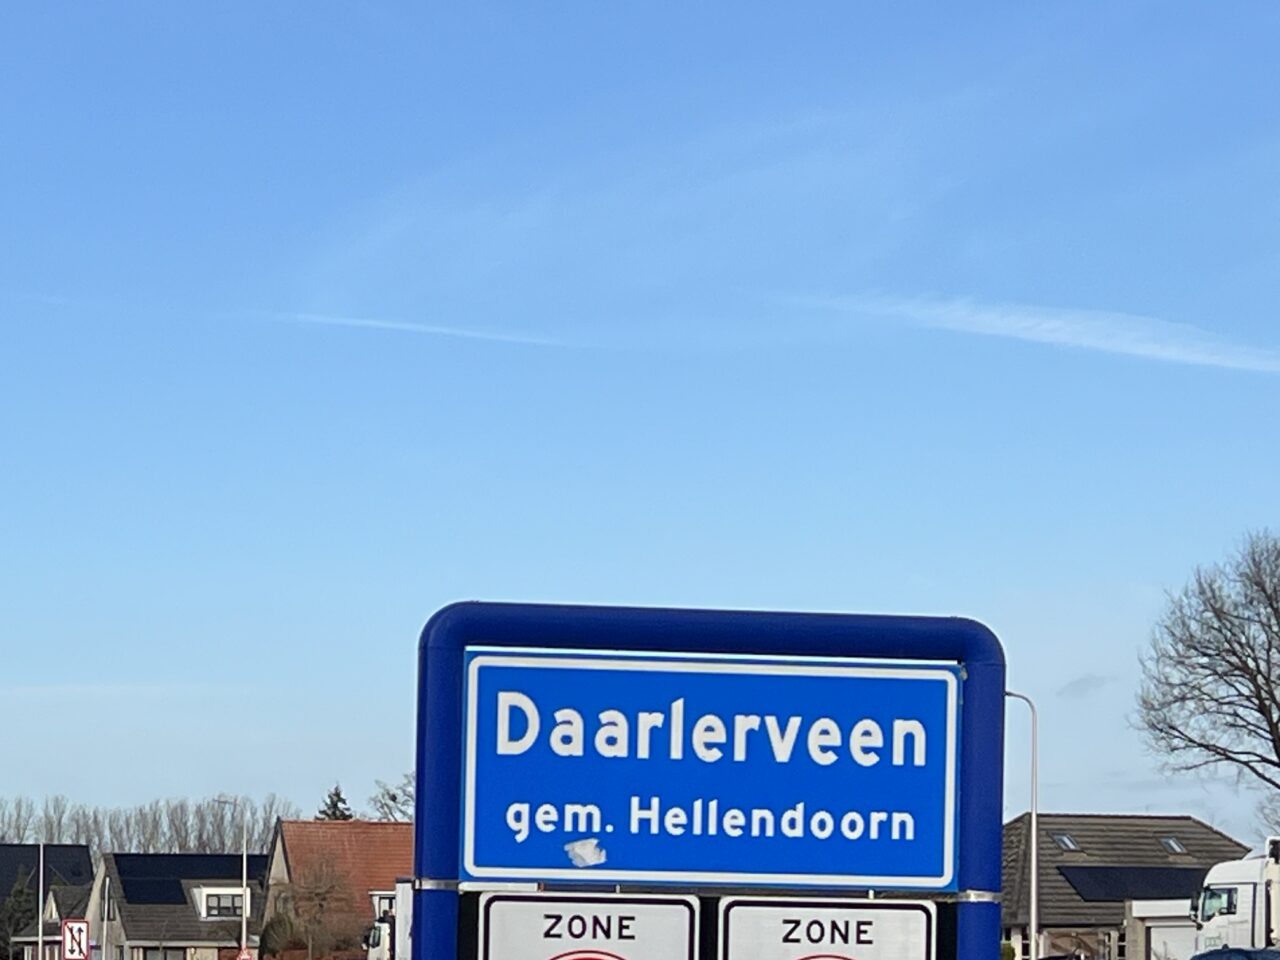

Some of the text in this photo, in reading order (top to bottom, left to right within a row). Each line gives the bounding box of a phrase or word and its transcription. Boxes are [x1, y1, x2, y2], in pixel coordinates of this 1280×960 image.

[496, 691, 926, 767] Daarlerveen
[506, 796, 914, 844] gem. Hellendoorn
[543, 913, 636, 941] ZONE
[782, 918, 874, 945] ZONE
